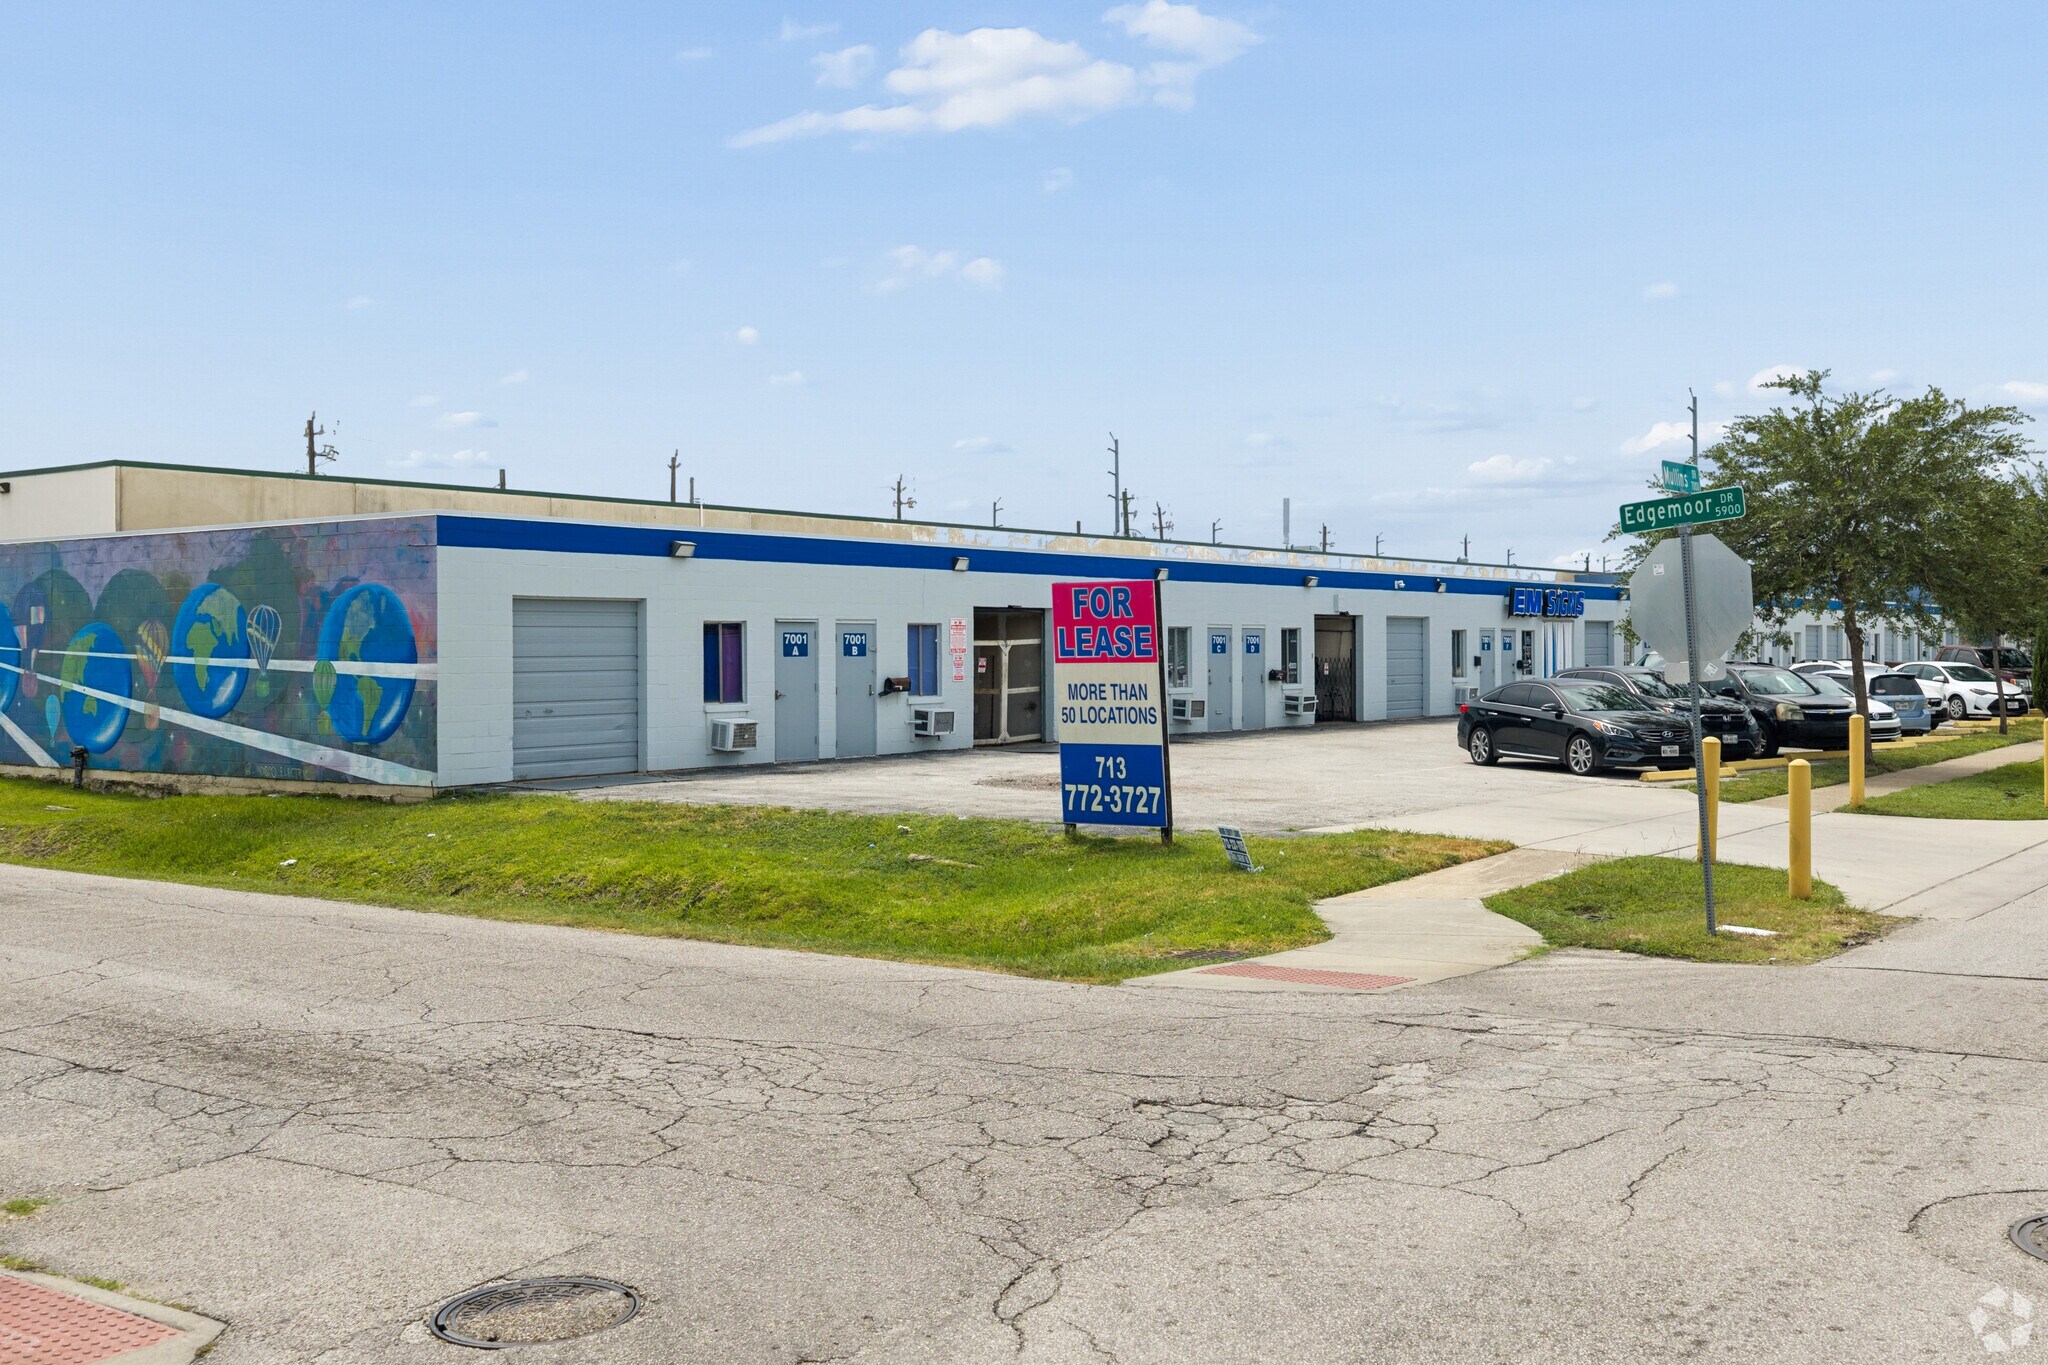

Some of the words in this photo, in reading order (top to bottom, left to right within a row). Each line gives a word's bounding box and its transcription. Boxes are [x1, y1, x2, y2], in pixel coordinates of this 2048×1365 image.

[1625, 499, 1712, 526] Edgemoor
[1720, 492, 1734, 504] DR
[1715, 503, 1741, 517] 5900
[1072, 586, 1134, 619] FOR
[1513, 588, 1543, 615] EM
[784, 633, 807, 645] 7001
[844, 634, 866, 645] 7001
[1057, 625, 1153, 658] LEASE
[1212, 636, 1226, 644] 7001
[792, 645, 800, 656] A
[852, 646, 858, 656] B
[1216, 645, 1222, 653] C
[1250, 645, 1255, 653] D
[1068, 683, 1107, 701] MORE
[1110, 683, 1148, 701] THAN
[1061, 706, 1076, 724] 50
[1080, 706, 1158, 725] LOCATIONS
[1095, 756, 1127, 779] 713
[1064, 784, 1161, 814] 772-3727
